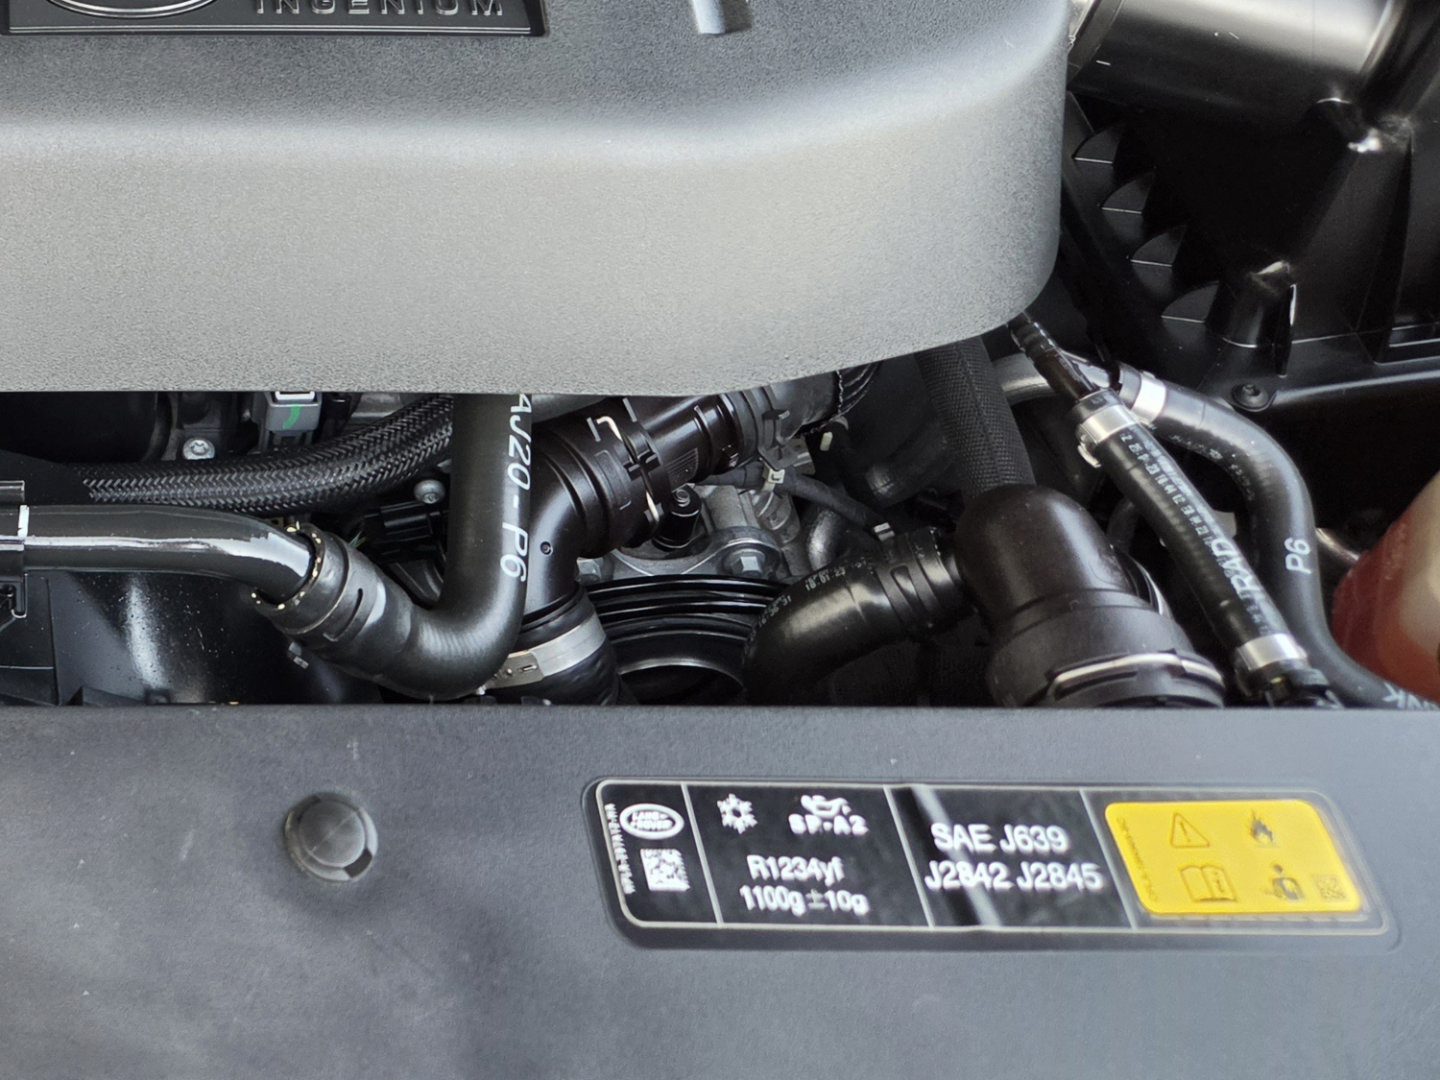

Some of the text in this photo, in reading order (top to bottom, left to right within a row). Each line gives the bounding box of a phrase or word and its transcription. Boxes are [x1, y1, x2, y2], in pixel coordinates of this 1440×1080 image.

[1210, 537, 1262, 599] RAD
[1284, 537, 1312, 575] P6
[931, 822, 1071, 854] SAE J639
[746, 854, 845, 887] R1234yf
[924, 860, 1104, 892] J2842 J2845
